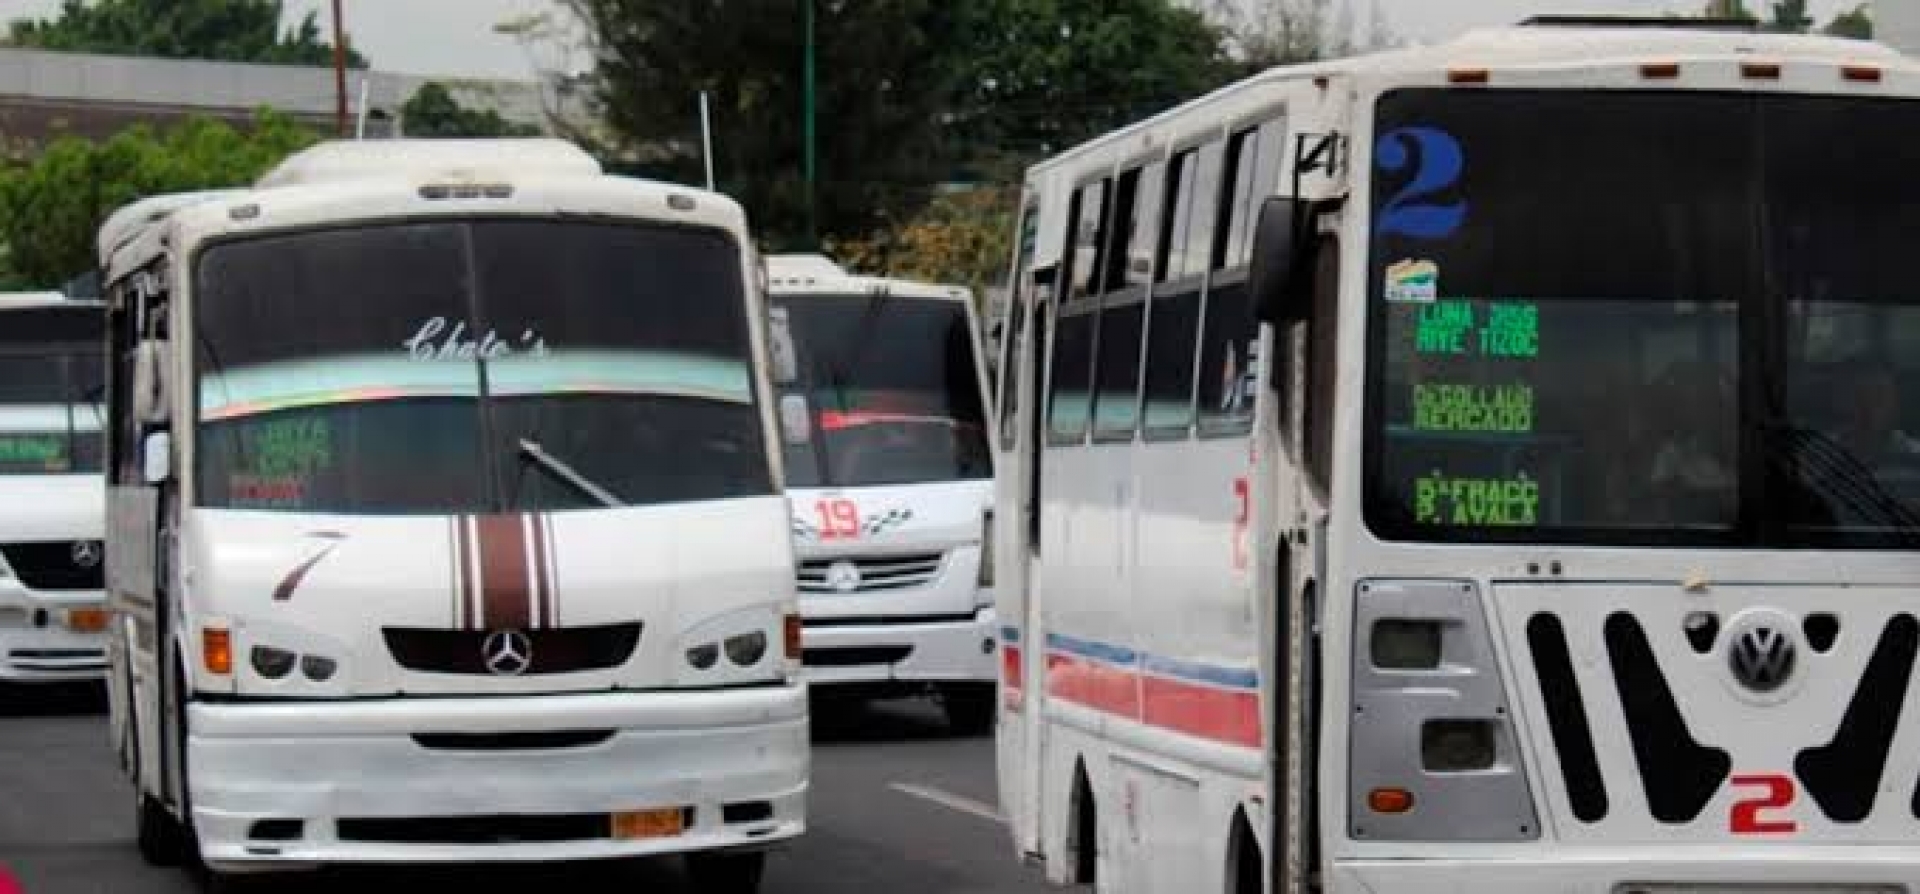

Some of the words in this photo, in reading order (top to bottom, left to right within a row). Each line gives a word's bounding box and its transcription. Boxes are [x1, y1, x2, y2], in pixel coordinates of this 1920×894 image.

[1376, 126, 1467, 238] 2
[815, 499, 859, 539] 19
[272, 530, 350, 602] 7
[1728, 773, 1798, 834] 2
